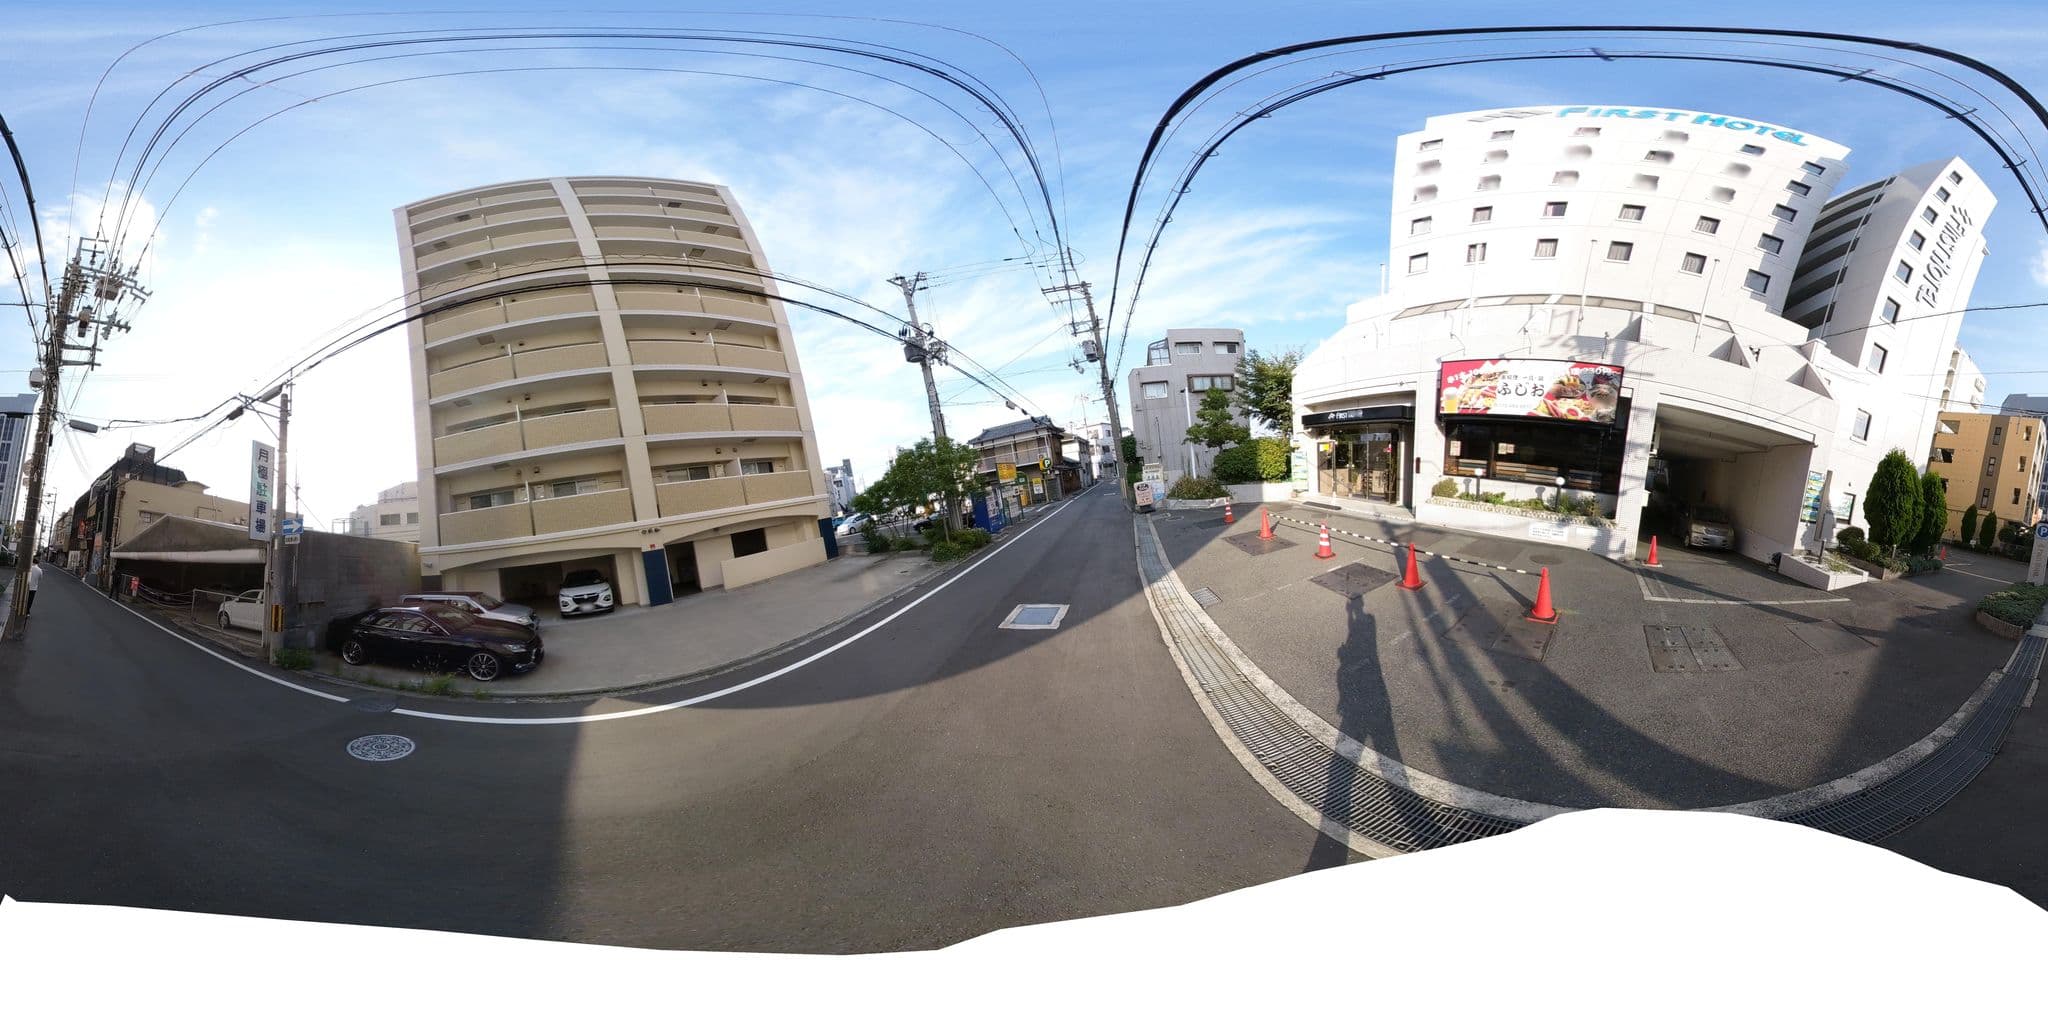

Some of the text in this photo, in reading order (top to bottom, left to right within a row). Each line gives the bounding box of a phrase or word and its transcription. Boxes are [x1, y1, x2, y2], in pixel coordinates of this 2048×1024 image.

[1556, 107, 1809, 147] FIRST HOTEL
[1497, 382, 1545, 397] ふじお
[255, 448, 269, 533] 月極駐車場
